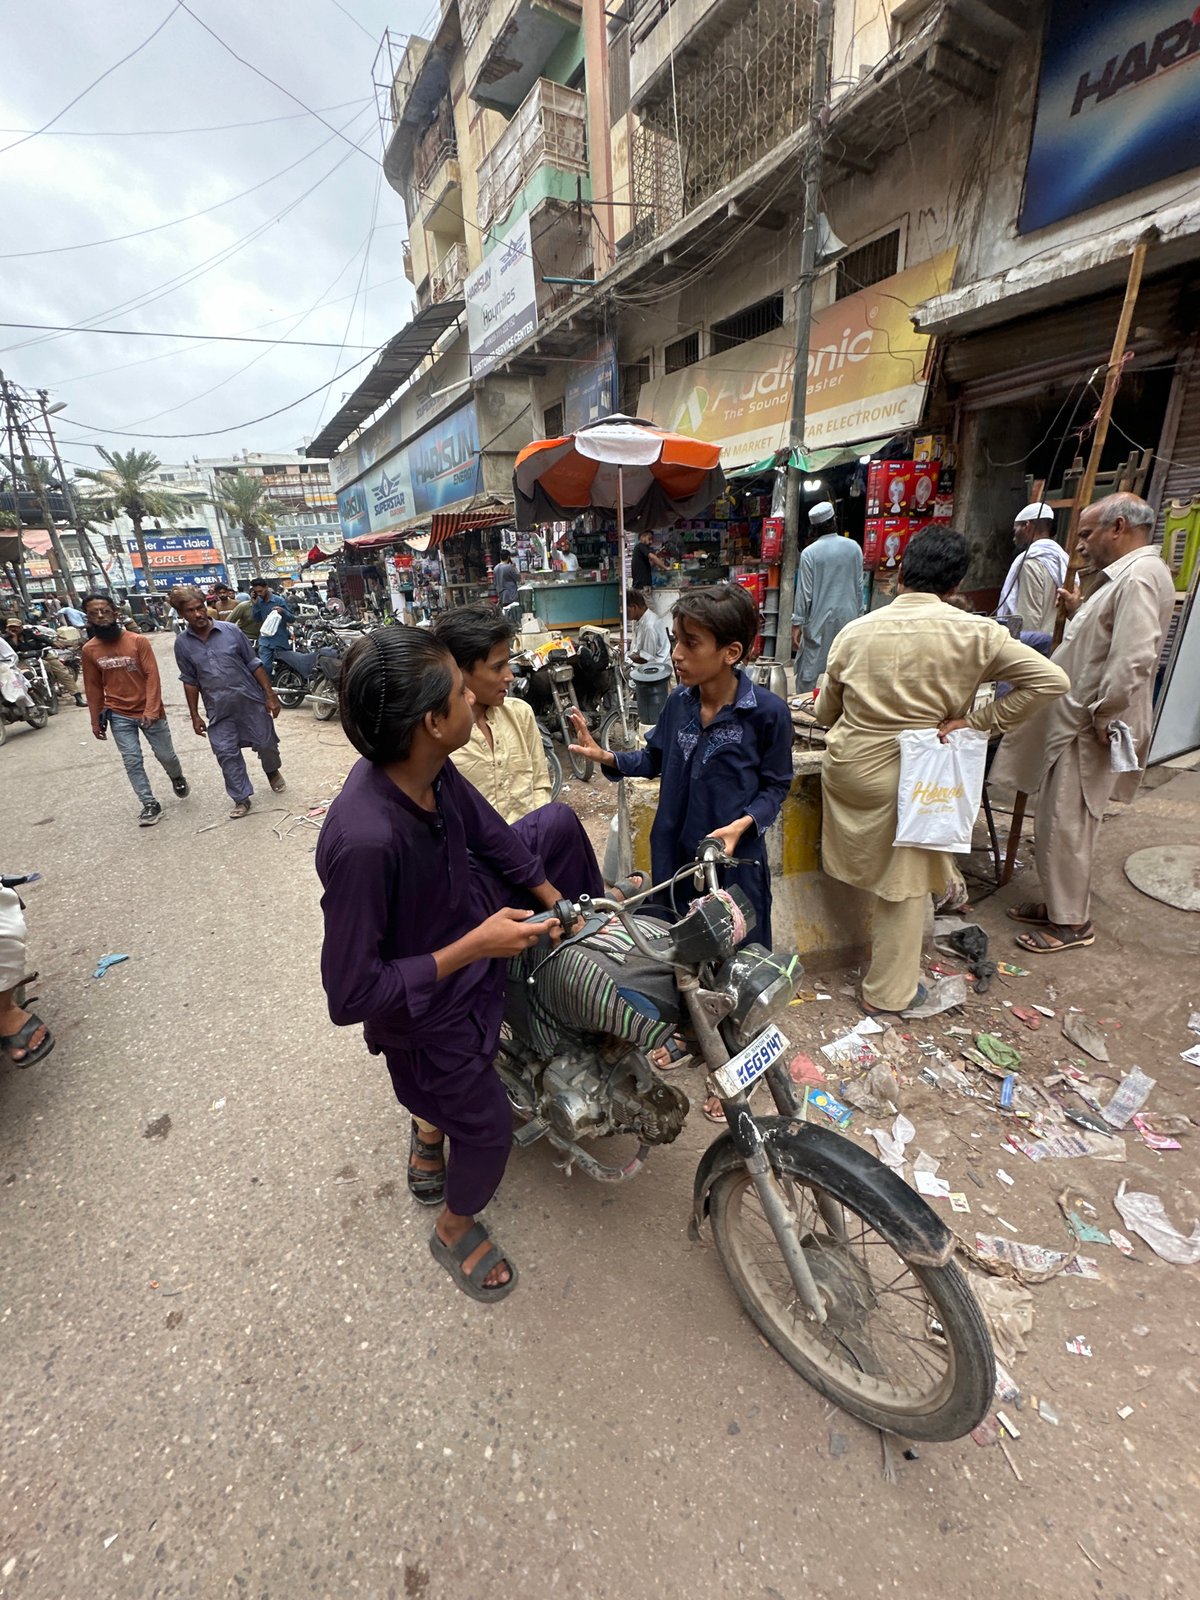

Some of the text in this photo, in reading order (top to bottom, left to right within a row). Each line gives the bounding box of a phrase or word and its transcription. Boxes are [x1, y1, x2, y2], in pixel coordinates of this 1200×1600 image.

[473, 350, 496, 374] CUSTOMER
[496, 335, 514, 358] SERVICE
[514, 320, 534, 343] CENTER
[724, 374, 844, 421] The Sound aster
[733, 436, 774, 456] MARKET
[826, 400, 908, 433] ELECTRONIC
[453, 468, 474, 486] ENERGY
[374, 492, 406, 516] SUPERSTAR
[130, 541, 157, 551] Hier
[183, 539, 210, 549] Haier
[154, 554, 186, 564] GREE
[194, 575, 223, 585] ORIENT
